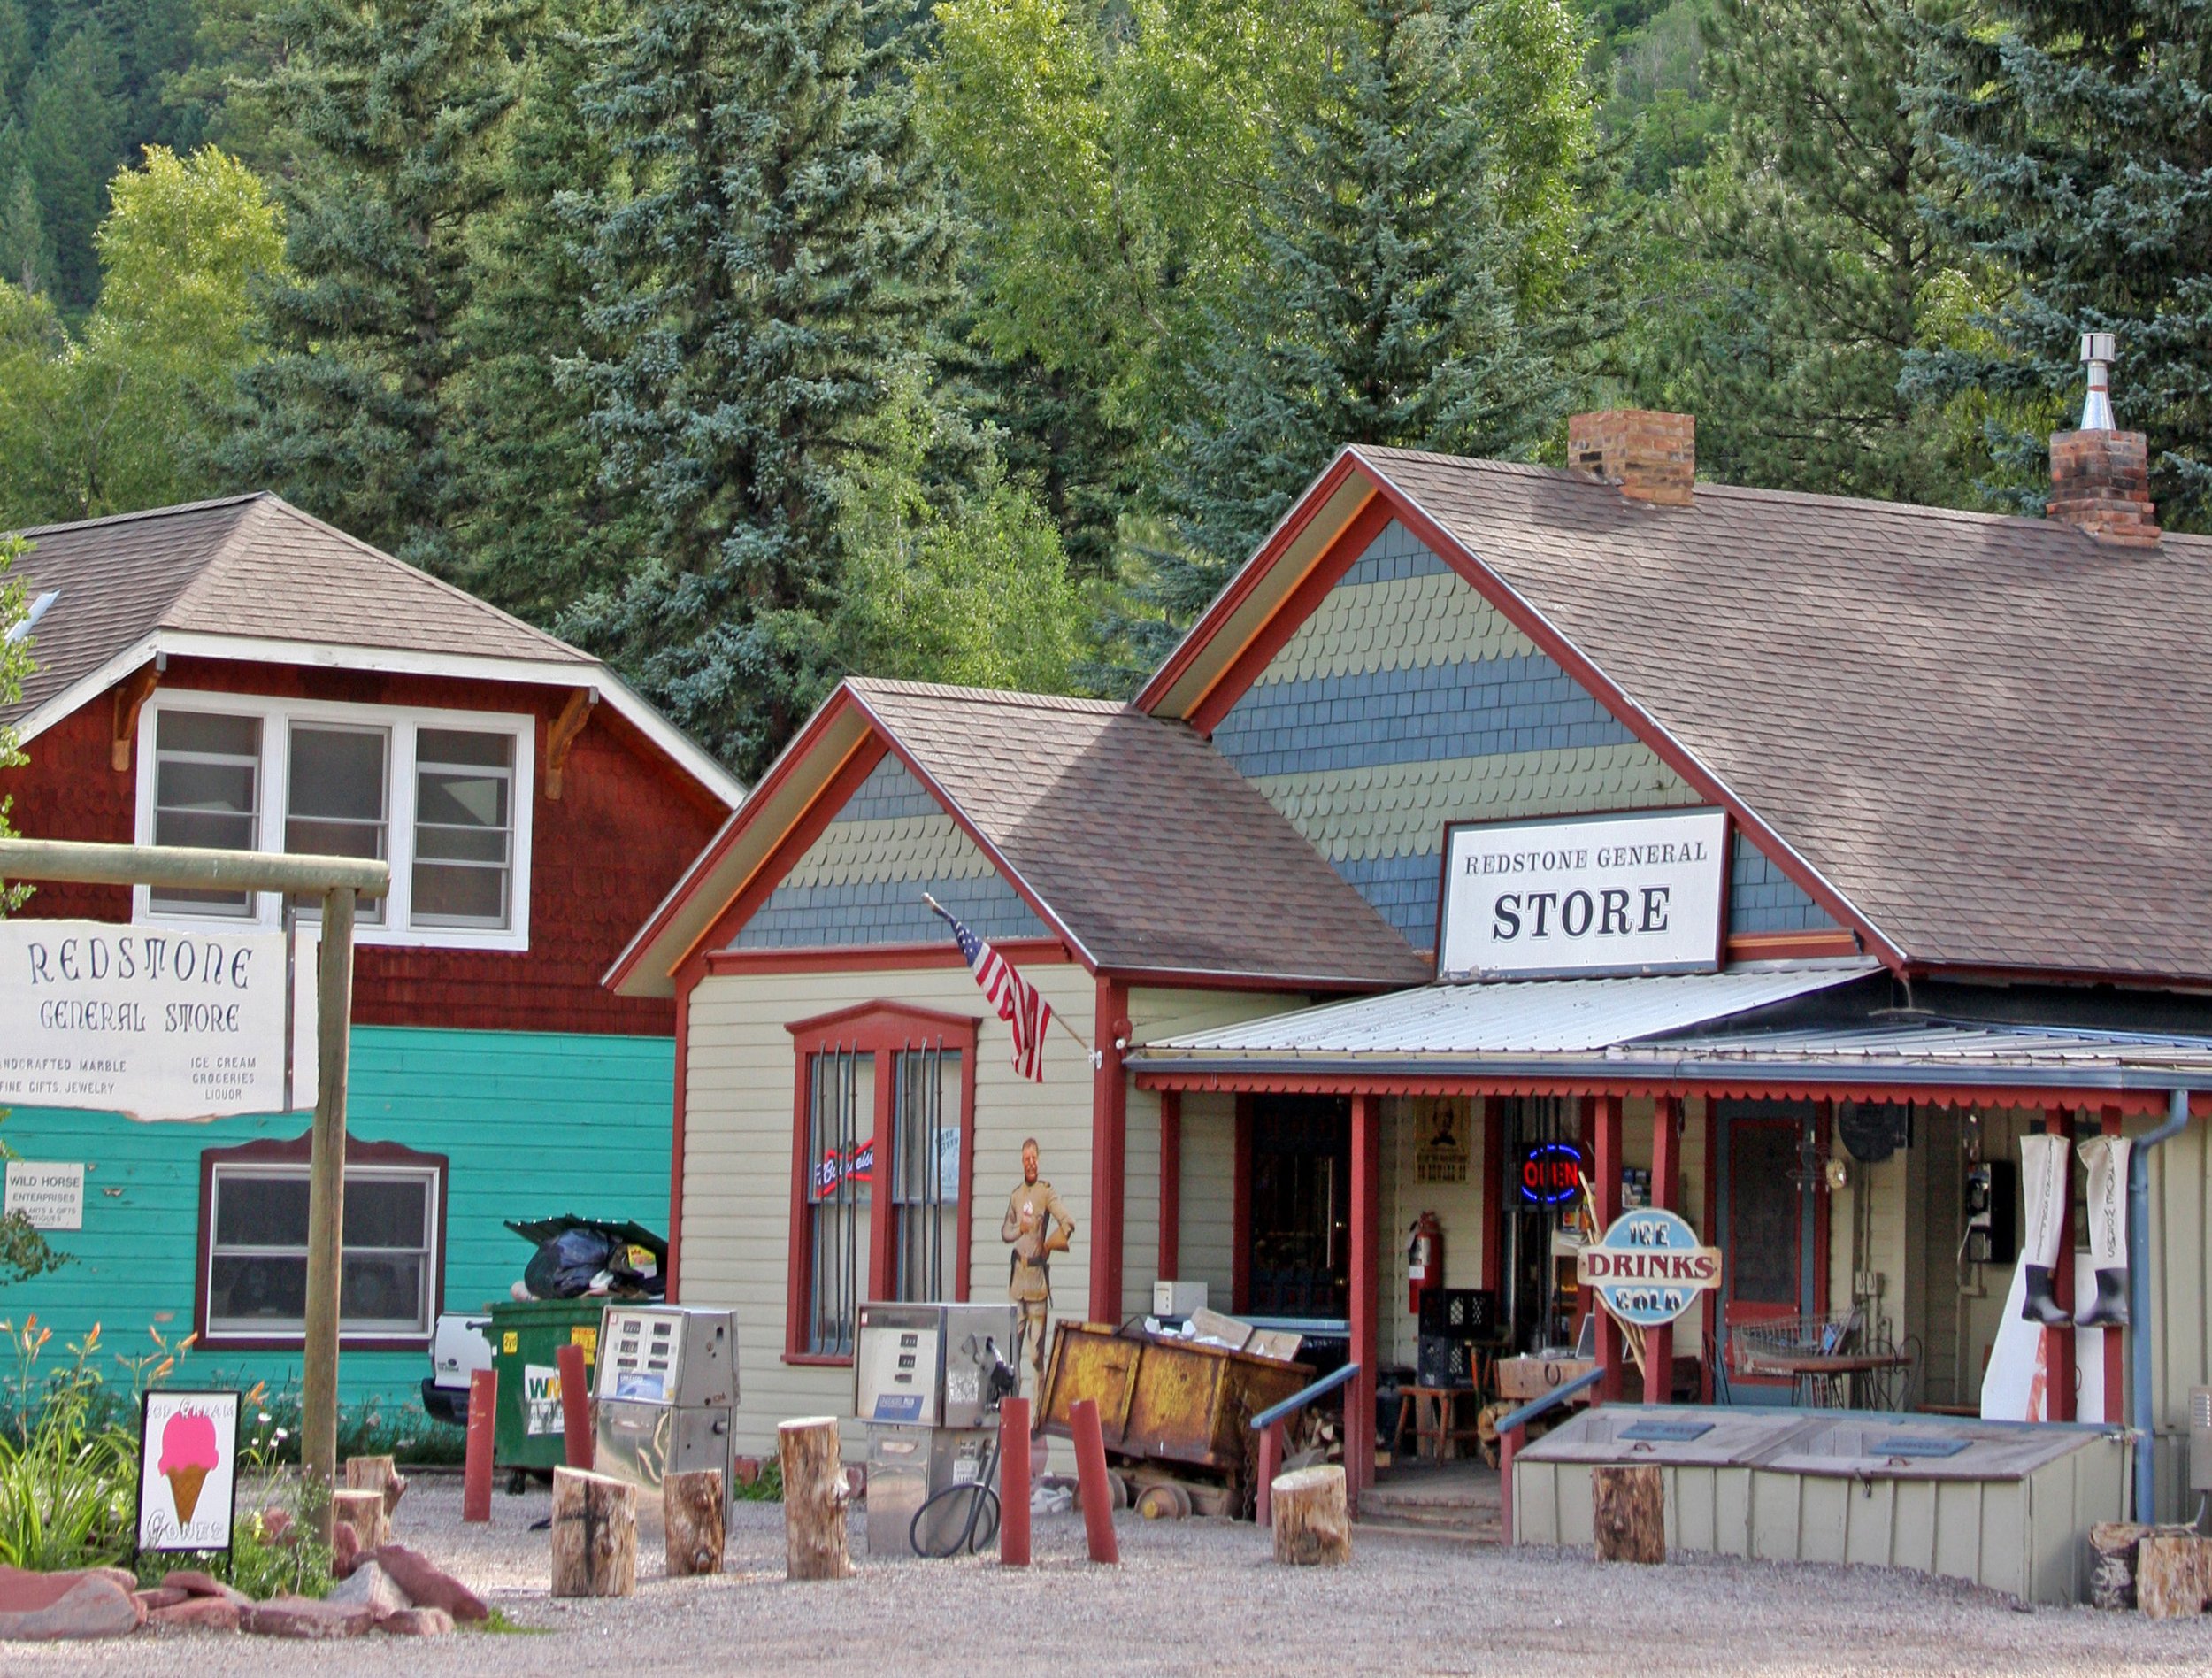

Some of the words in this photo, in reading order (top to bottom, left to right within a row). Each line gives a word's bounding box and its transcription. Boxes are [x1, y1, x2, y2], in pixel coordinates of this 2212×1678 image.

[1464, 850, 1588, 875] REDSTONE
[1597, 842, 1708, 868] GENERAL
[1492, 884, 1671, 942] STORE
[28, 937, 254, 989] REDSTONE
[40, 1000, 146, 1032] GENERAL
[165, 1003, 241, 1033] STORE
[0, 1058, 71, 1071] NDCRAFTED
[79, 1060, 127, 1073] MARBLE
[190, 1057, 210, 1069] ICE
[216, 1057, 257, 1069] CREAM
[65, 1082, 114, 1095] JEWELRY
[192, 1073, 255, 1085] GROCERIES
[10, 1176, 37, 1187] WILD
[42, 1176, 80, 1188] HORSE
[12, 1193, 76, 1203] ENTERPRISES
[1628, 1220, 1671, 1248] ICE
[1586, 1253, 1715, 1280] DRINKS
[1615, 1289, 1683, 1313] COLD
